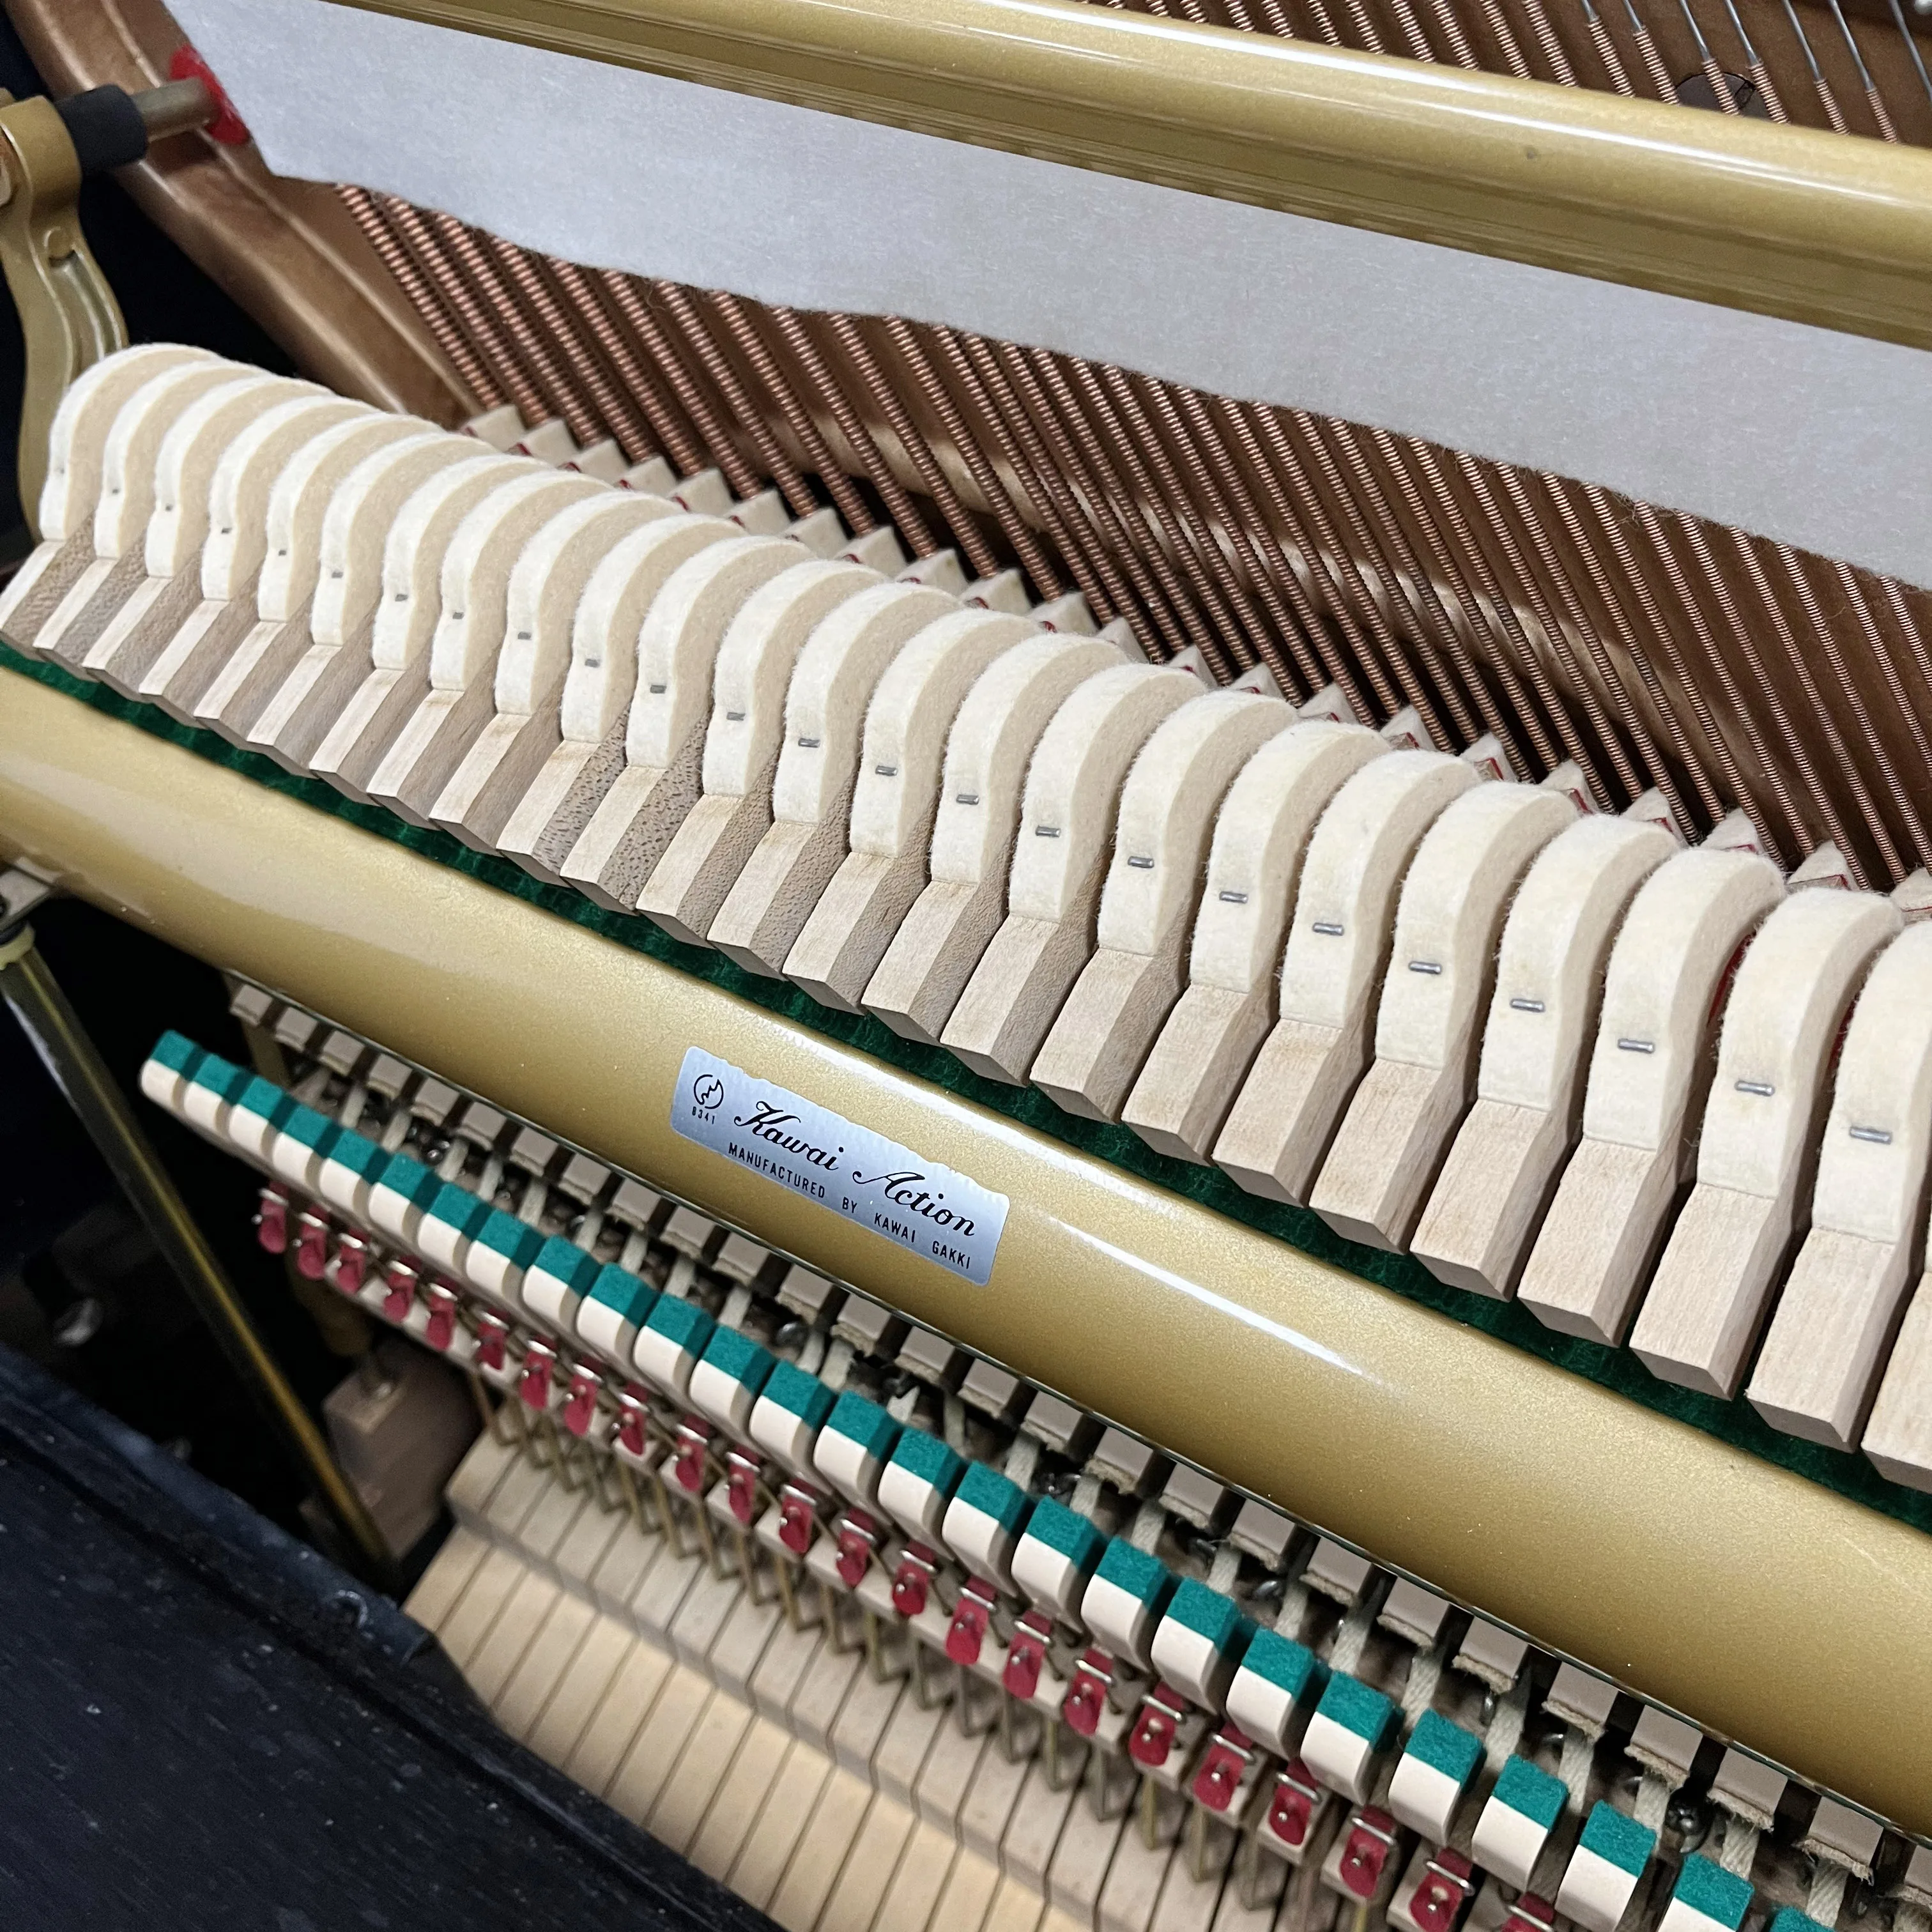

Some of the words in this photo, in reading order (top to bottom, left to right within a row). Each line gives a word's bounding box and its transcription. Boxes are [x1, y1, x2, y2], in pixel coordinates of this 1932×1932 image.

[692, 1106, 716, 1124] 8341
[734, 1101, 844, 1171] Kawai
[852, 1171, 975, 1236] Action
[728, 1142, 825, 1199] MANUFACTURED
[842, 1197, 857, 1214] BY
[874, 1213, 916, 1243] KAWAI
[931, 1240, 970, 1269] GAKKI
